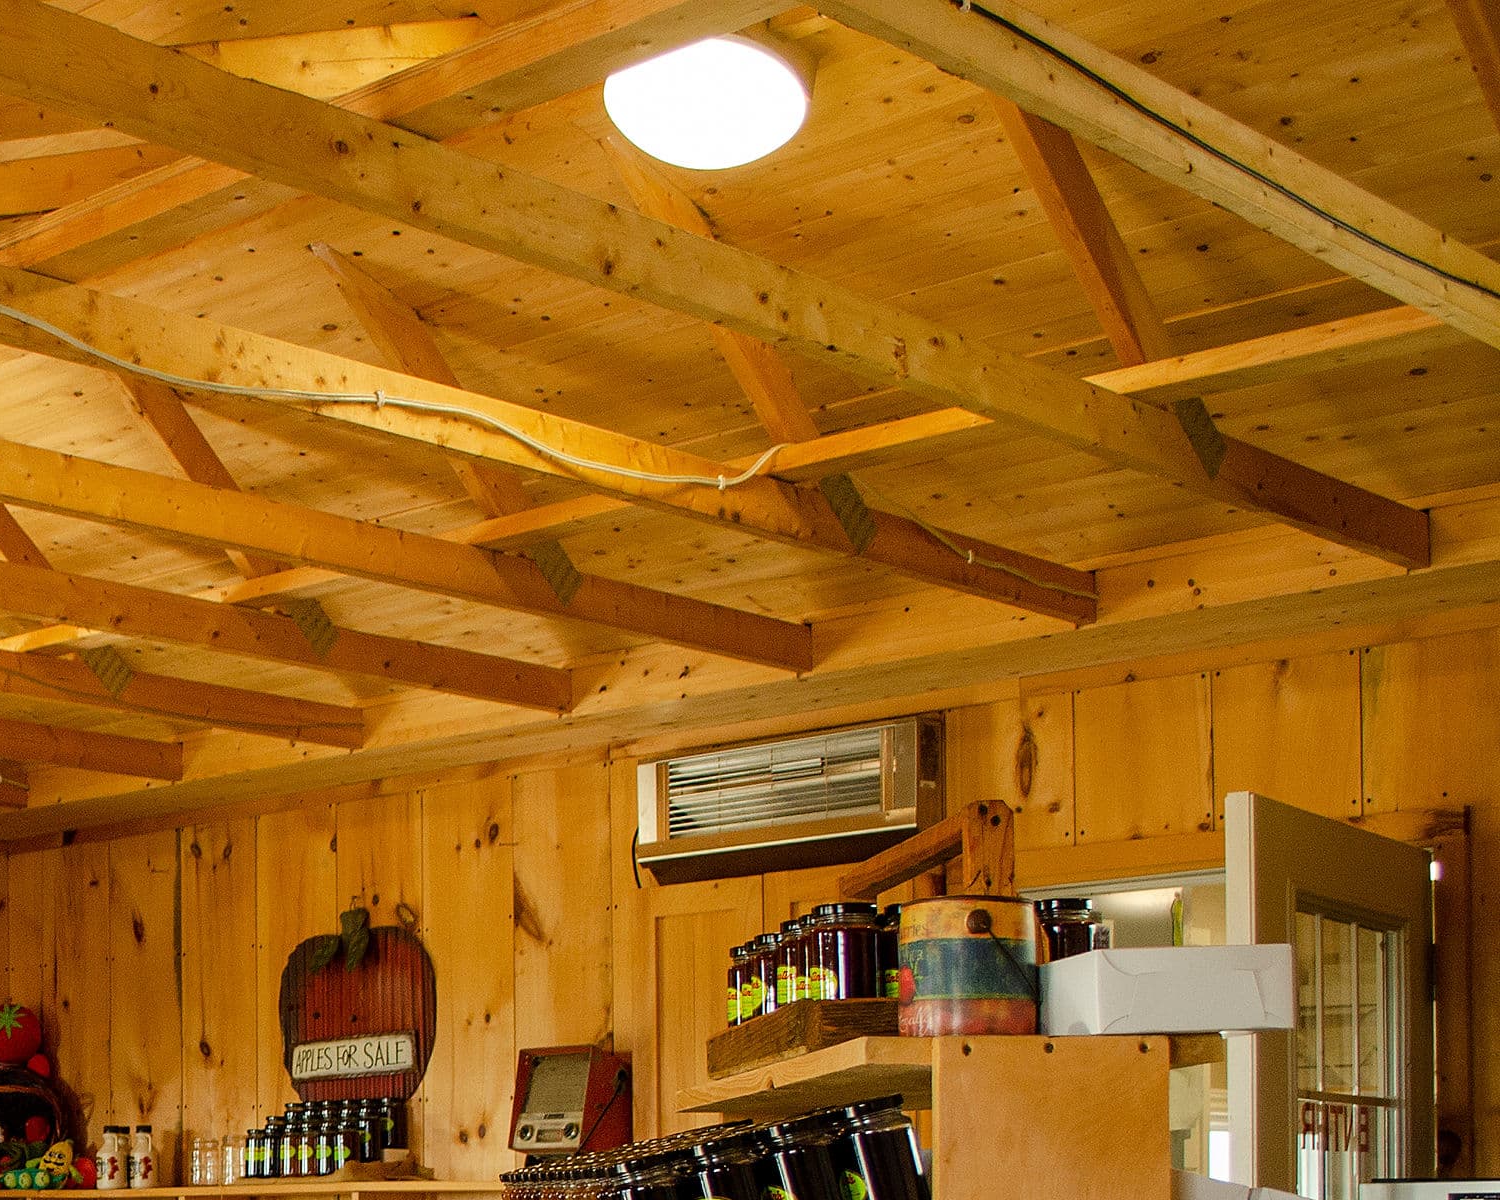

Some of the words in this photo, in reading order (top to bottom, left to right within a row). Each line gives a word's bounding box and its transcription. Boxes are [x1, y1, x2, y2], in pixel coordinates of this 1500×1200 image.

[295, 1047, 333, 1075] APPLES
[336, 1044, 359, 1071] FOR
[363, 1041, 406, 1069] SALE
